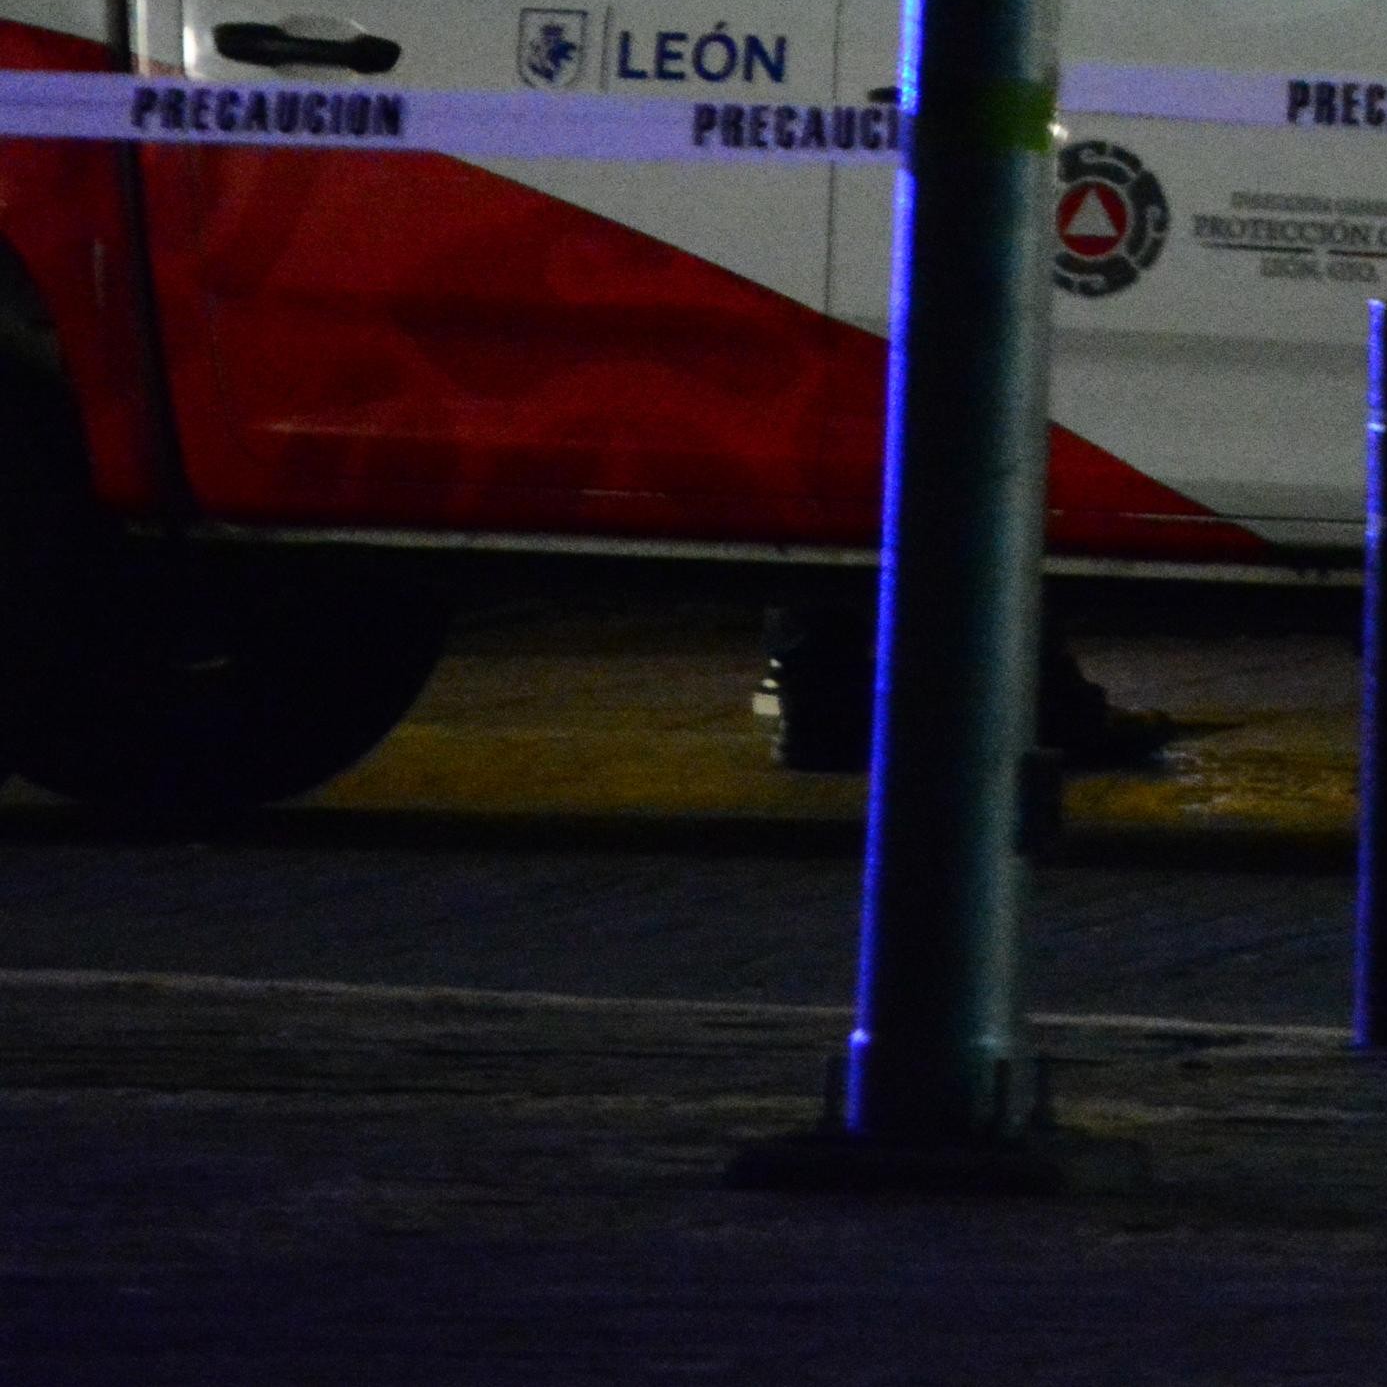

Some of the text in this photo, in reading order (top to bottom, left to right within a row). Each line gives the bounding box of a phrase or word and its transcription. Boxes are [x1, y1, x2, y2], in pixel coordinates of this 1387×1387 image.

[617, 20, 786, 83] LEÓN
[131, 87, 402, 135] PRECAUCION
[693, 103, 899, 150] PRECAUCI
